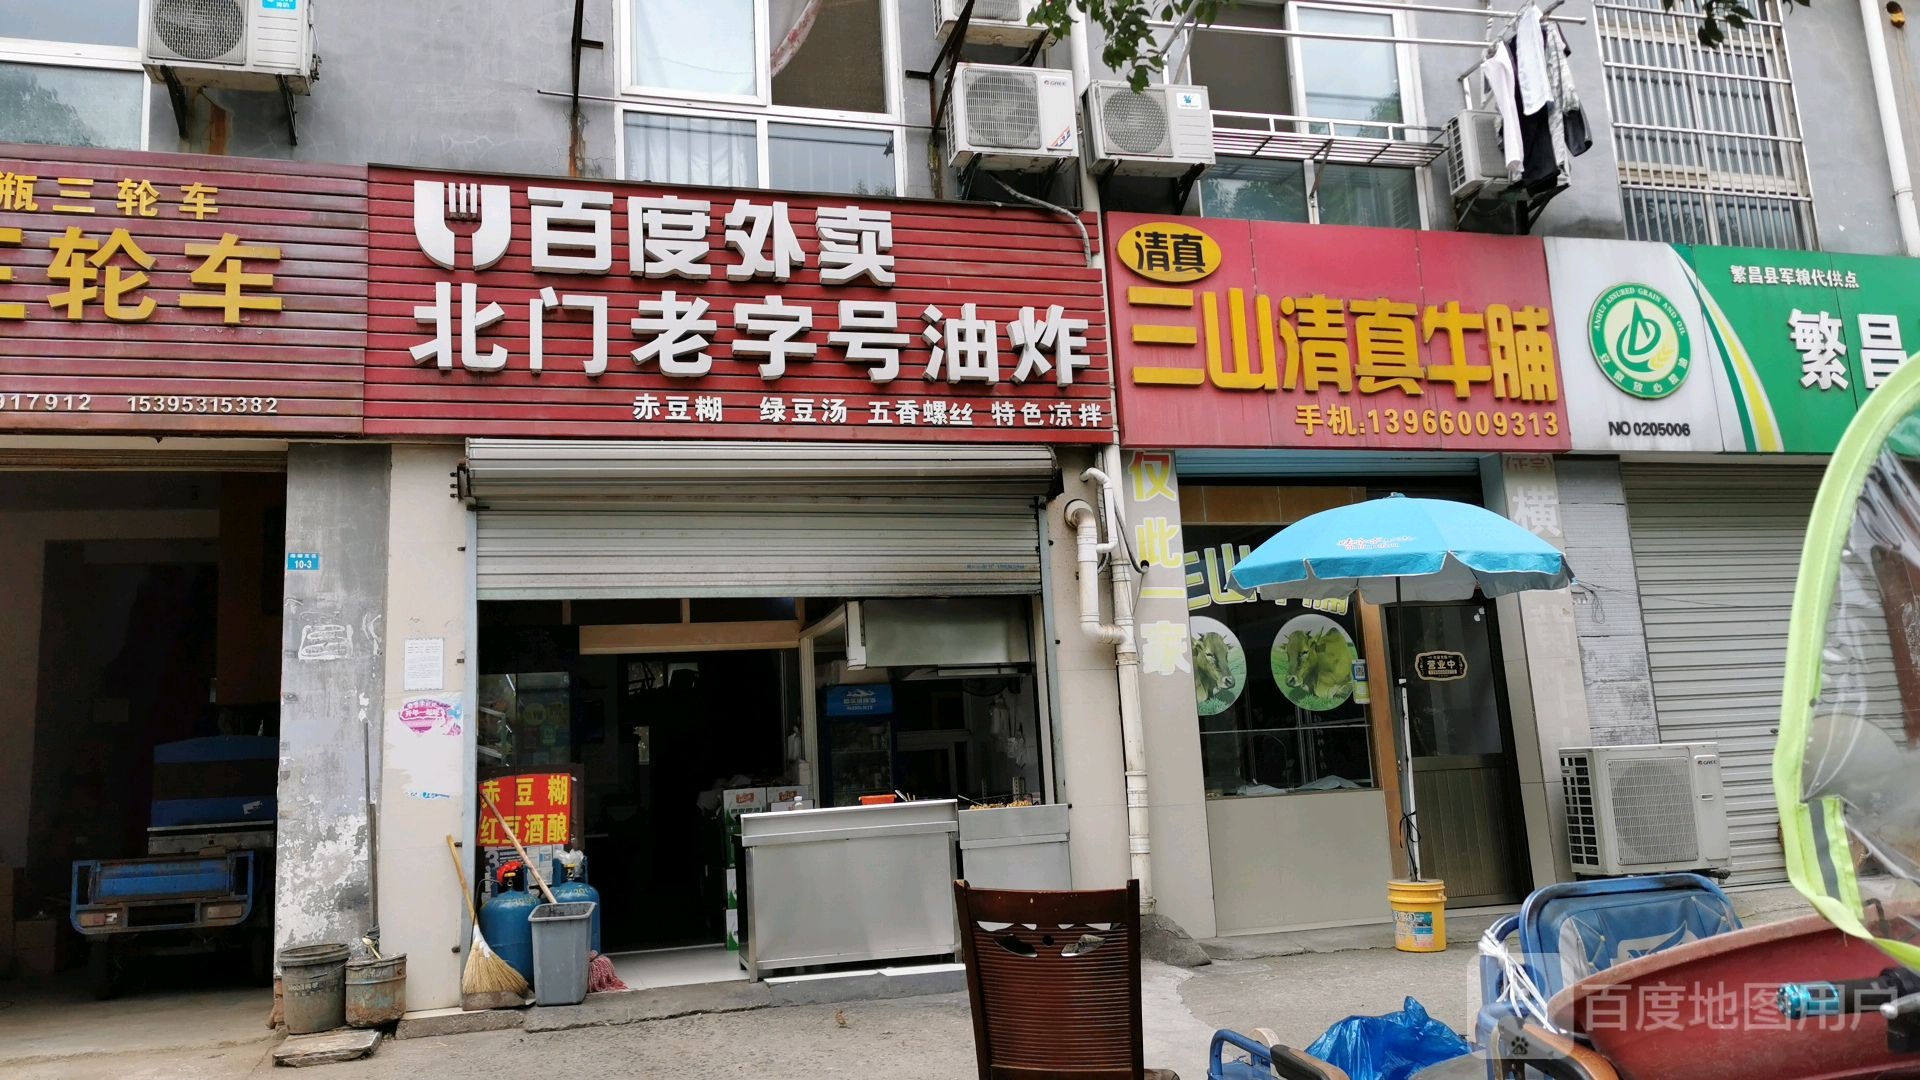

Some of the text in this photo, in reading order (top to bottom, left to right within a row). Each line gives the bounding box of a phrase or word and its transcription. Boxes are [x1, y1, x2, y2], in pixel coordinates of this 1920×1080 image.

[527, 186, 896, 287] 百度外卖
[1134, 231, 1206, 274] 清真
[0, 226, 283, 325] 轮车
[1730, 264, 1860, 289] 繁昌县军粮代供点
[409, 281, 1091, 387] 北门老字号油炸
[1662, 302, 1677, 320] AND
[1676, 320, 1687, 337] OIL
[1126, 287, 1559, 403] 三山清真牛脯
[1787, 308, 1908, 390] 繁昌
[127, 395, 279, 414] 15395315382
[632, 393, 1103, 427] 赤豆糊 绿豆汤 五香螺丝 特色凉拌
[1608, 421, 1691, 437] NO 0205006
[294, 559, 312, 569] 10-3
[1427, 659, 1456, 670] 营业中
[480, 775, 568, 809] 赤豆糊
[480, 812, 567, 844] 红豆酒酿
